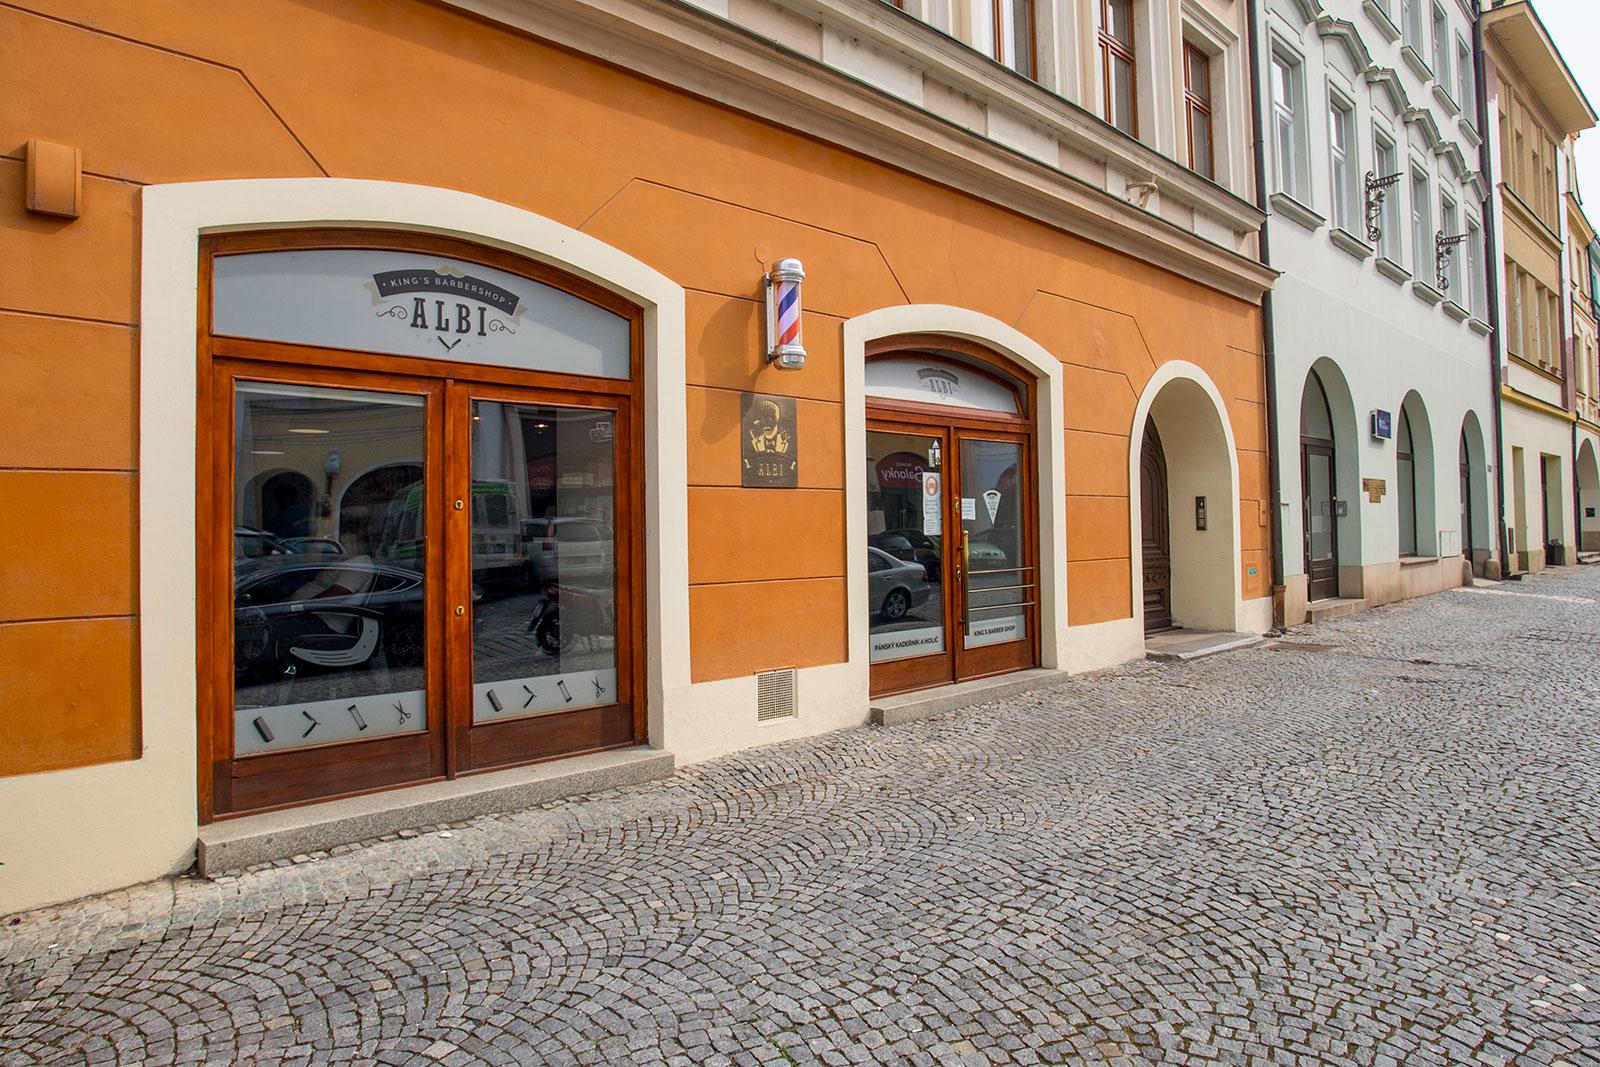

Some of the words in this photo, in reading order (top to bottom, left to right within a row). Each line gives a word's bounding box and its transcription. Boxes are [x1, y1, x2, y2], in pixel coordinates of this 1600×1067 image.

[390, 276, 430, 287] KING'S
[435, 277, 506, 303] BARBERSHOP
[410, 296, 487, 336] ALBI
[929, 378, 953, 394] ALBI
[758, 463, 784, 477] ALBI
